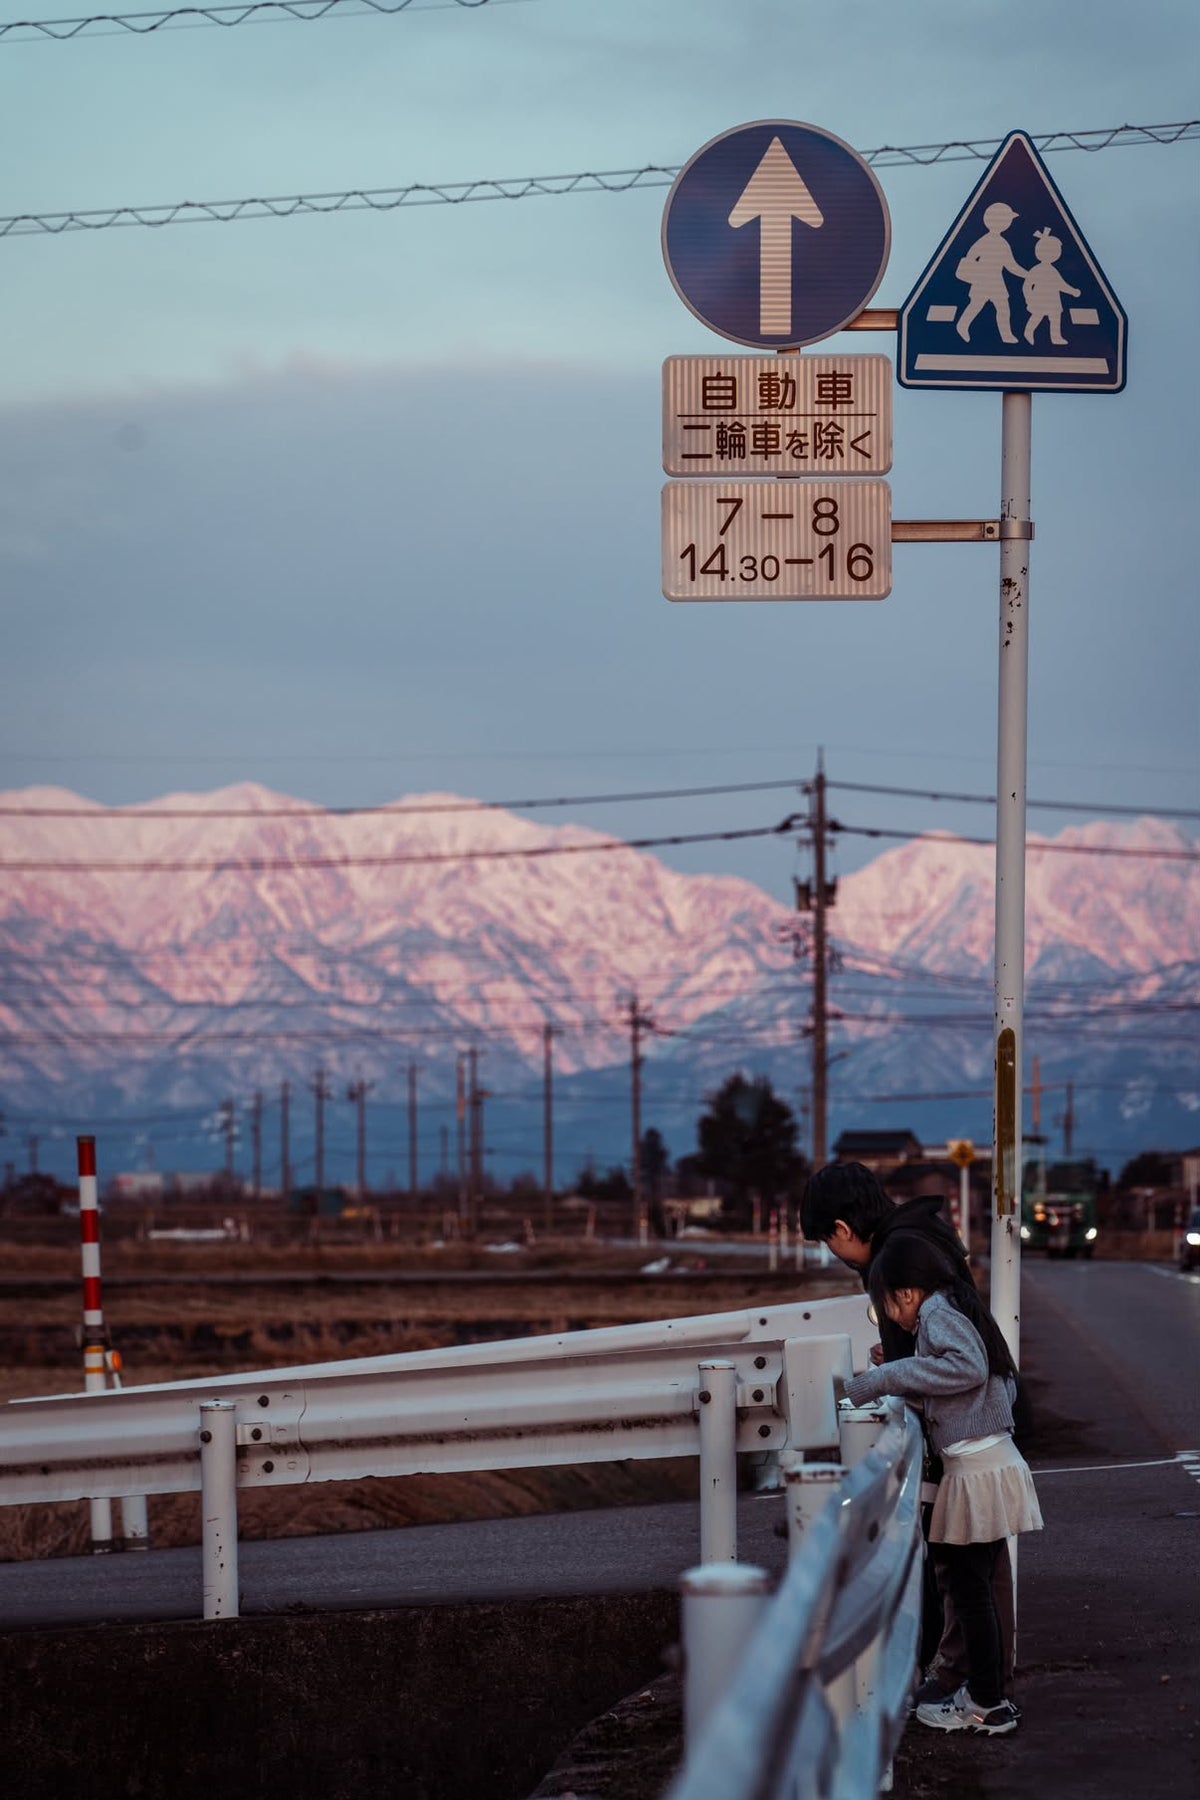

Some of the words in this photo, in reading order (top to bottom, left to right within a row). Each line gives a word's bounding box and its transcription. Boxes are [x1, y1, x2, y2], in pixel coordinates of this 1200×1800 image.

[701, 371, 854, 411] 自動車
[681, 420, 872, 461] 二輪車を除く
